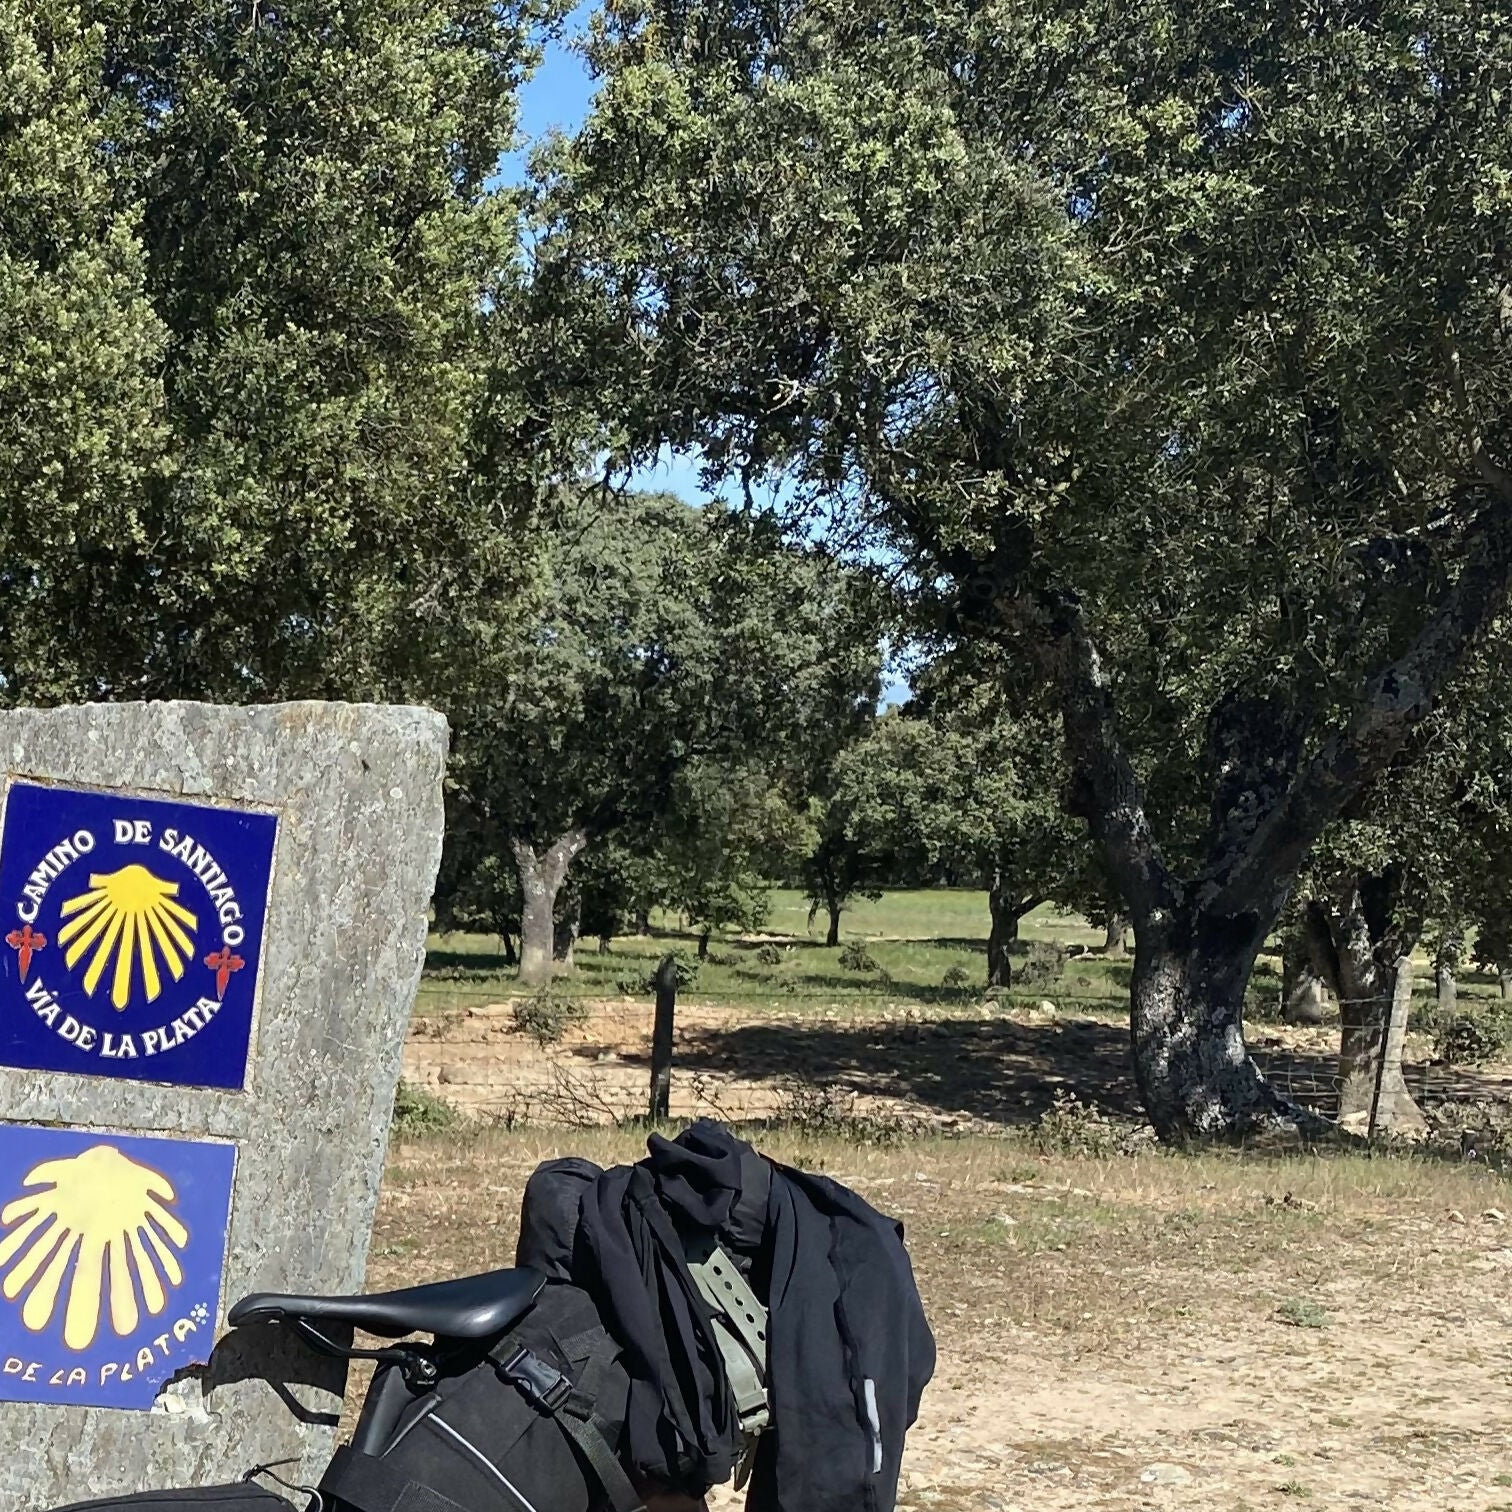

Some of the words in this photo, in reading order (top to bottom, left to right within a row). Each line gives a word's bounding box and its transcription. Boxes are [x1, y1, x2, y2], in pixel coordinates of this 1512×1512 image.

[17, 829, 96, 923] CAMINO
[113, 818, 153, 845] DE
[159, 828, 245, 946] SANTIAGO
[57, 1017, 98, 1051] DE
[99, 1033, 139, 1058] LA
[142, 997, 224, 1057] PLATA
[3, 1357, 43, 1382] DE
[49, 1367, 87, 1386] LA
[100, 1318, 198, 1387] PLATA
